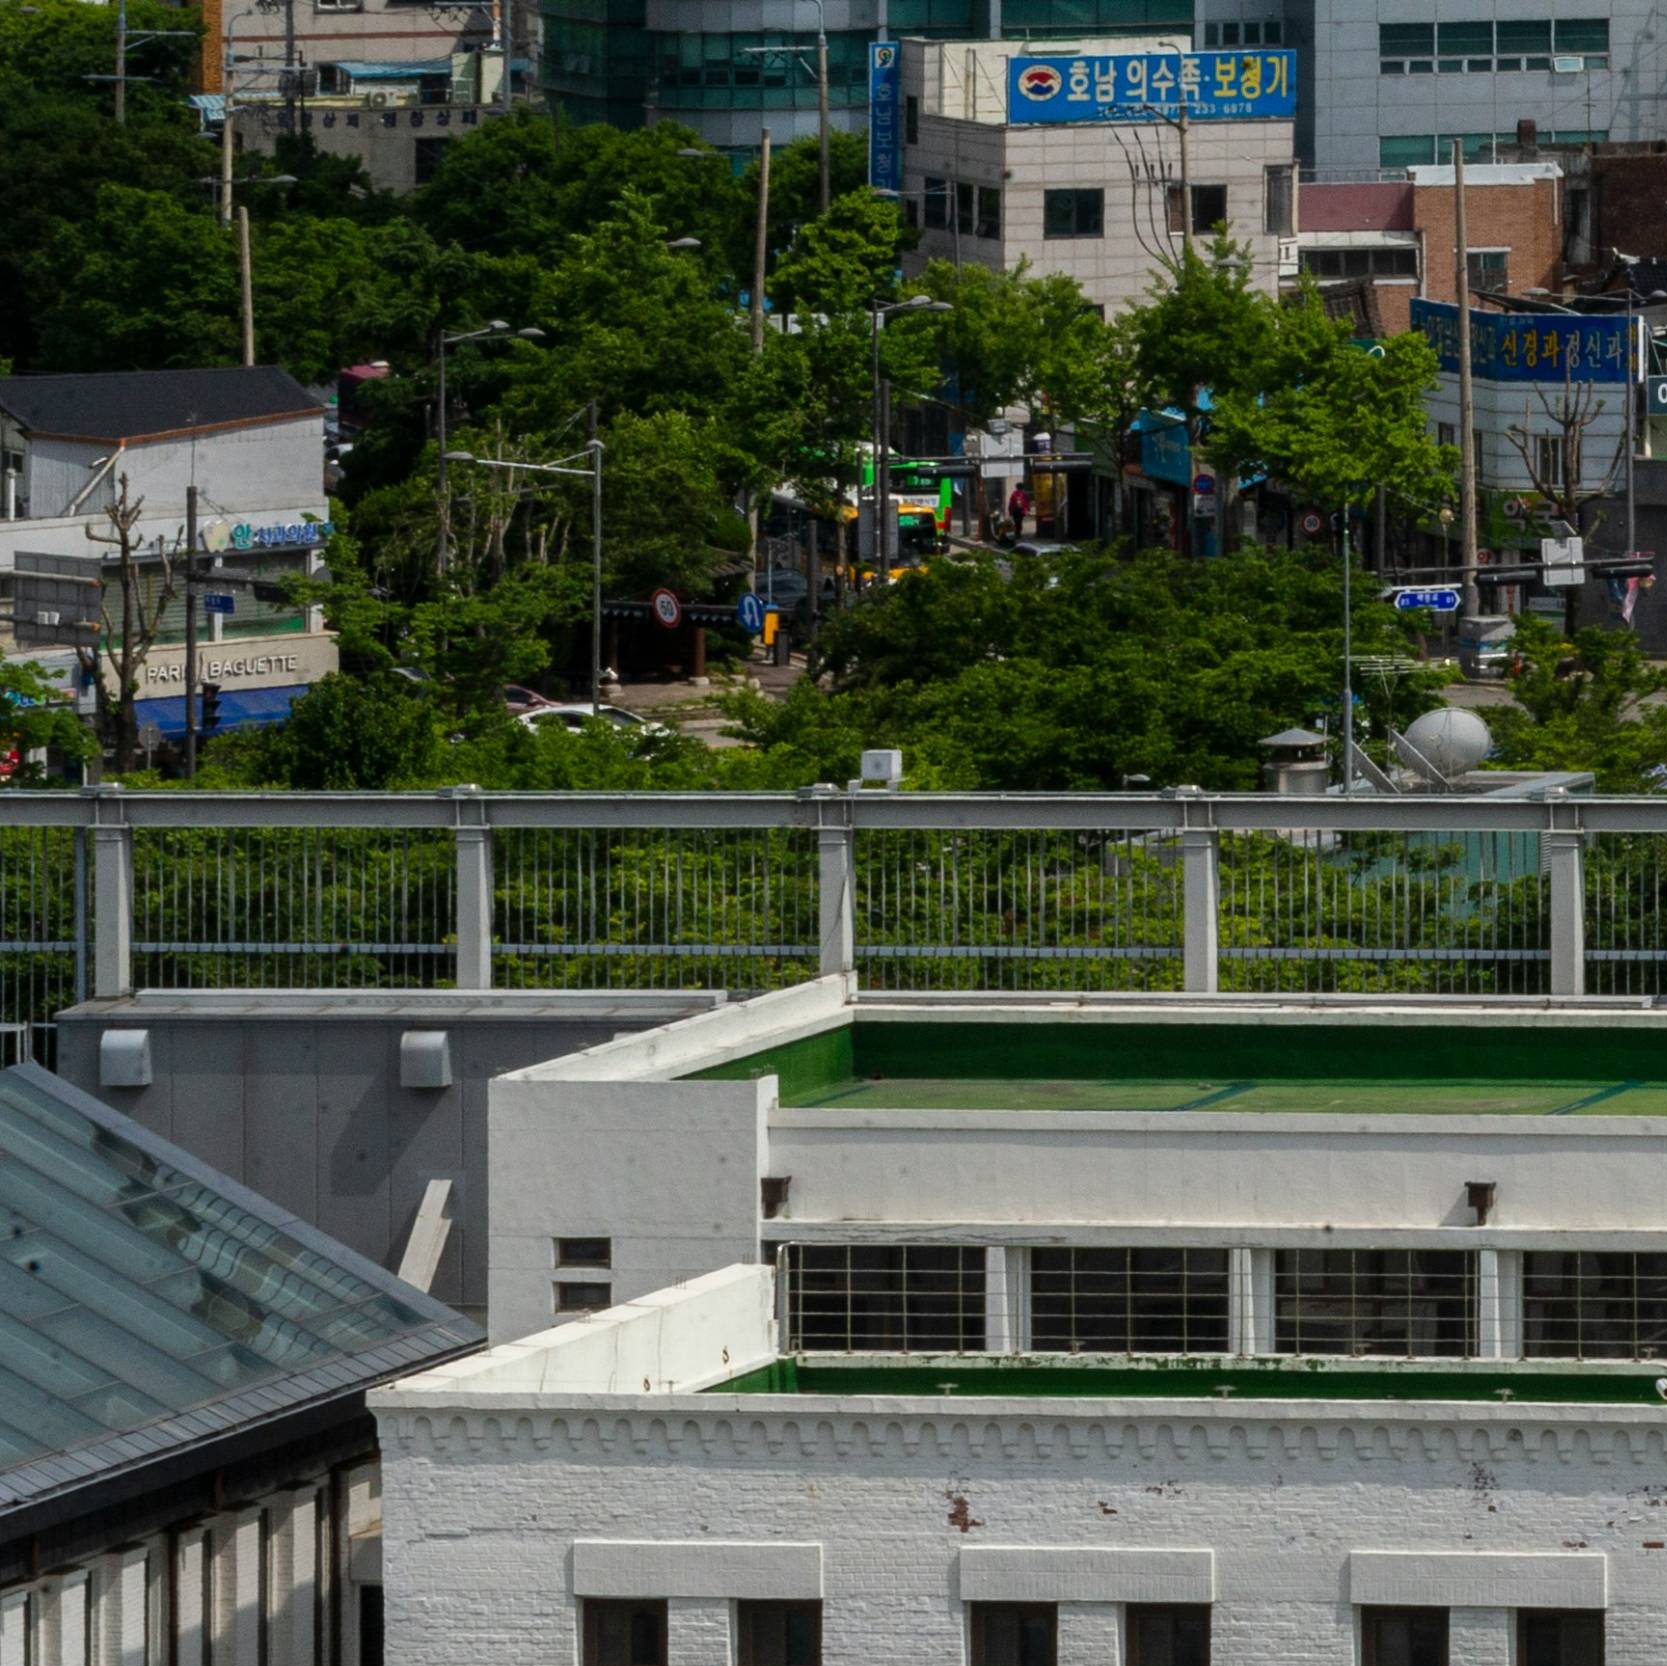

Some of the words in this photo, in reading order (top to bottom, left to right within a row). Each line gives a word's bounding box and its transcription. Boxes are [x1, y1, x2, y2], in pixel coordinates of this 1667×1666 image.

[1066, 61, 1116, 102] 호남
[231, 523, 253, 549] 안
[144, 664, 187, 684] PARI
[209, 655, 298, 679] BAGUETTE
